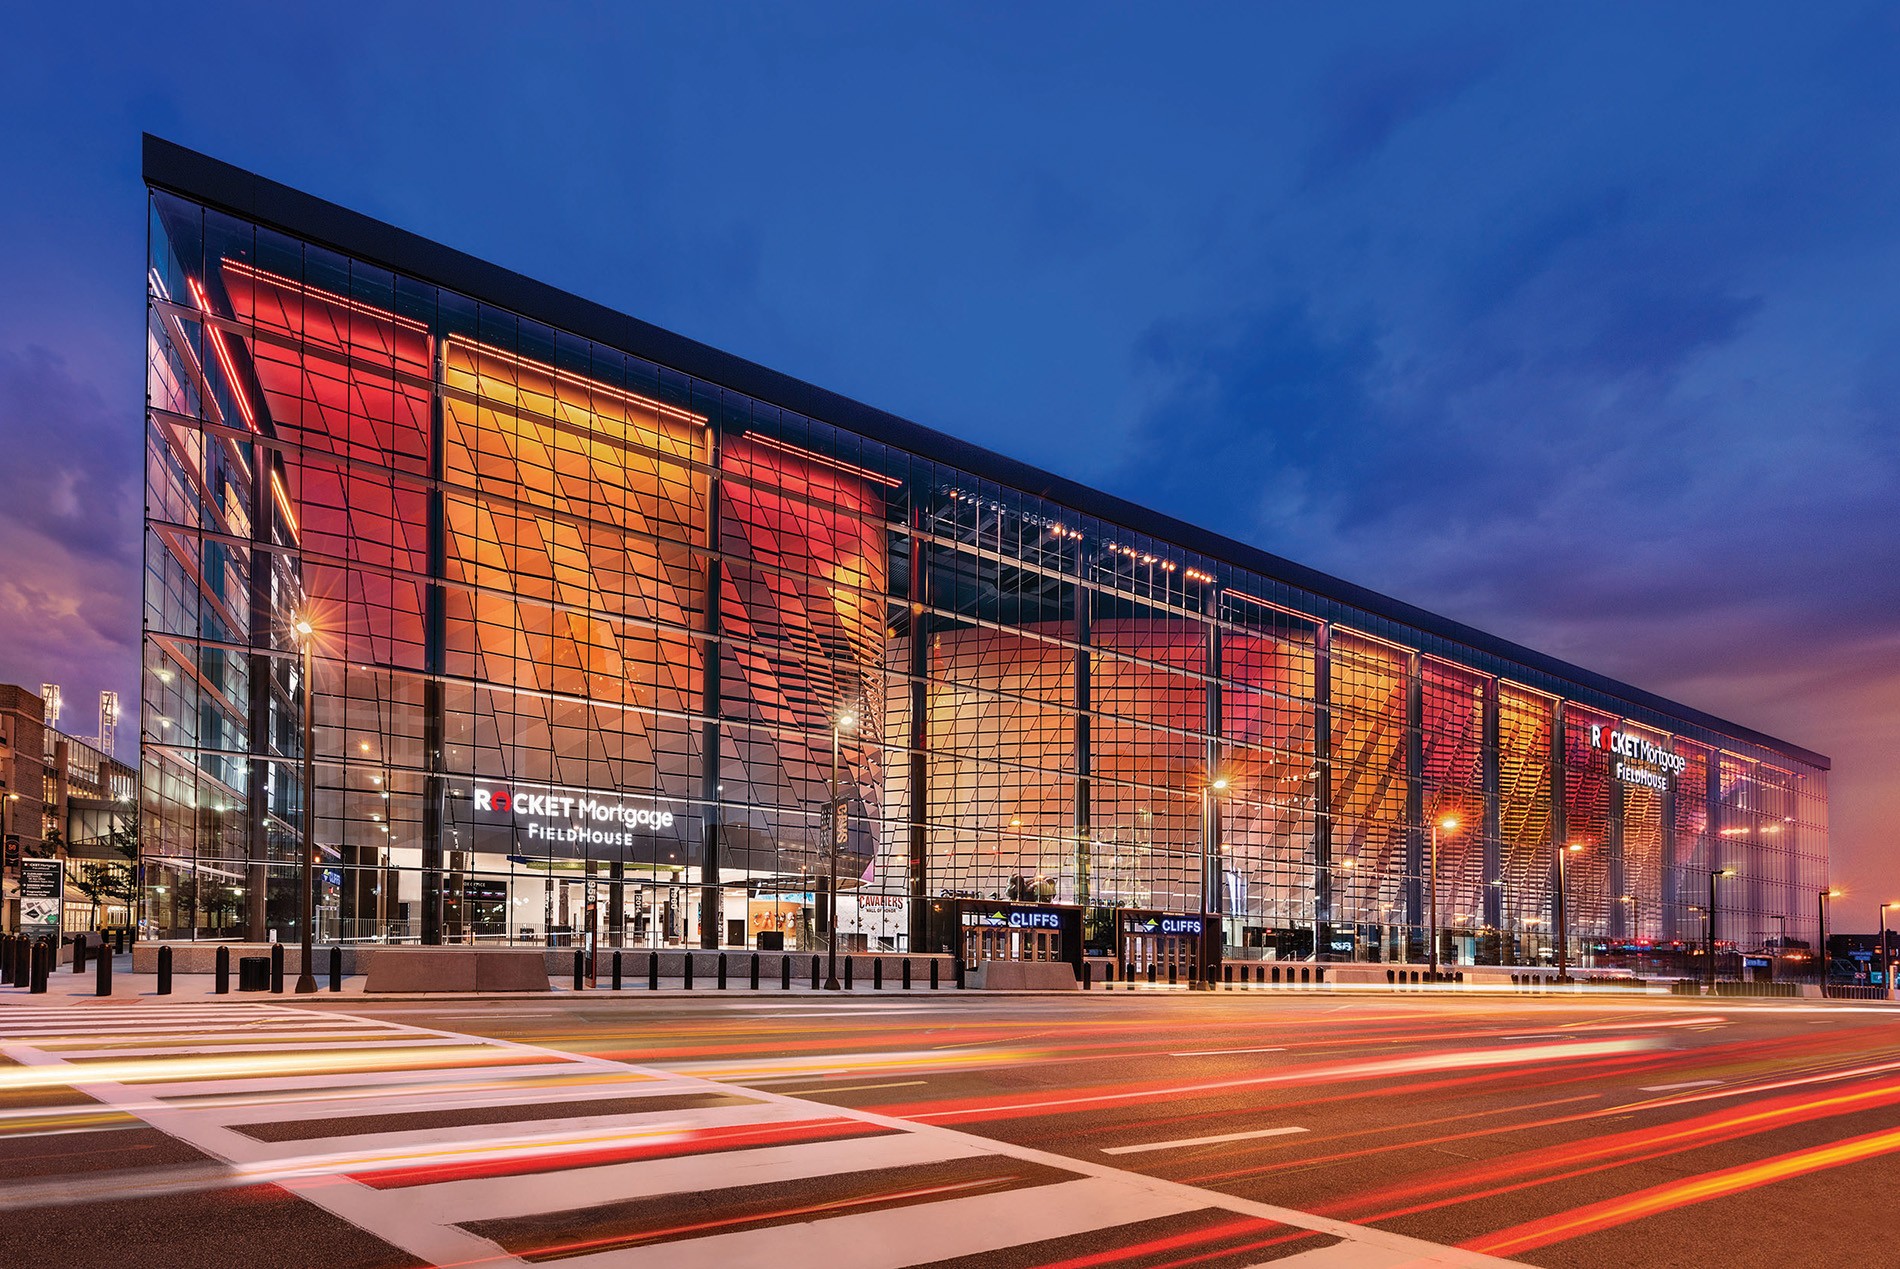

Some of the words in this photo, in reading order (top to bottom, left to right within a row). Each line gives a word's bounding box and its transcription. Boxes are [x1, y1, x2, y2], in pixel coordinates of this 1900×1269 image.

[1591, 724, 1640, 758] ROCKET
[1640, 740, 1686, 775] Mortgage
[474, 788, 575, 818] ROCKET
[579, 798, 674, 831] Mortgage
[859, 895, 904, 910] CAVALIERS
[1010, 912, 1059, 927] CLIFFS
[1162, 919, 1201, 933] CLIFFS
